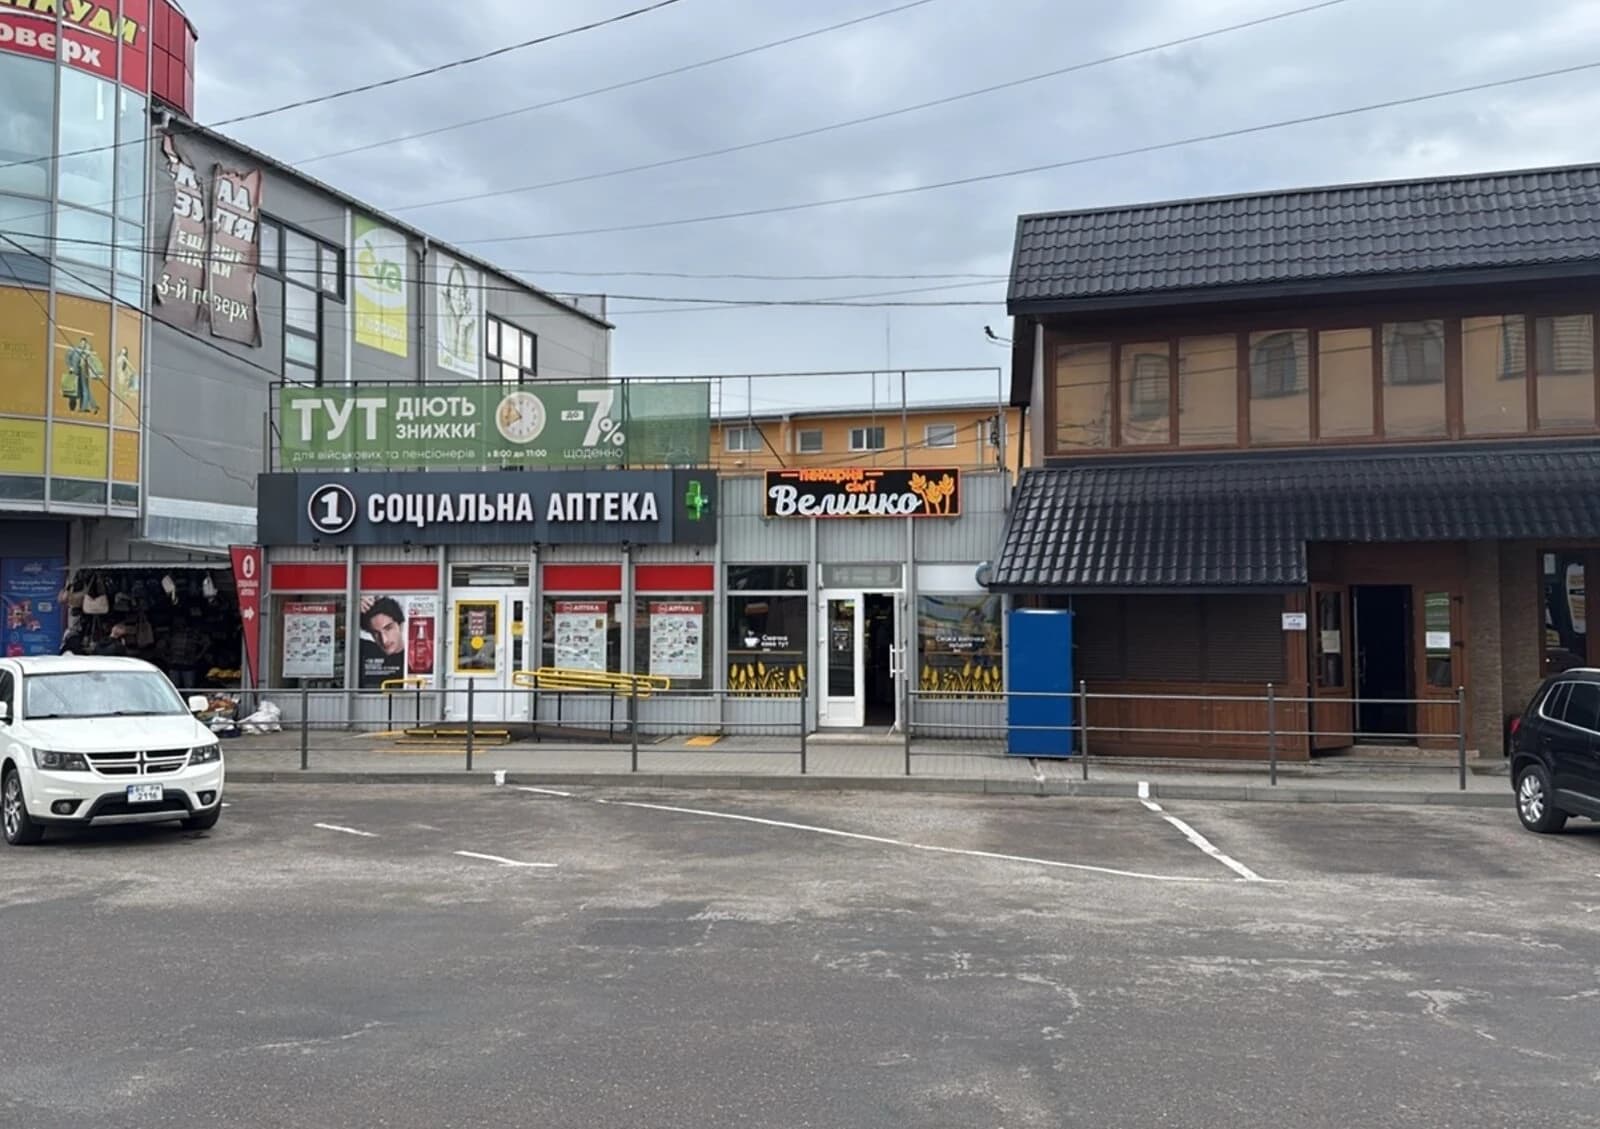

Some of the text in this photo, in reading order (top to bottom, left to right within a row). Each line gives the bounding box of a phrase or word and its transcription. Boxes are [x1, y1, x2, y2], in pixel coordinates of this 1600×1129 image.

[291, 398, 387, 441] ТУТ
[395, 397, 476, 421] ДІЮТЬ
[395, 423, 476, 439] ЗНИЖКИ
[292, 451, 315, 462] для
[402, 449, 475, 463] пенсіонерів
[563, 448, 624, 460] щоденно
[320, 491, 658, 527] 1 СОЦІАЛЬНА АПТЕКА
[768, 484, 923, 515] Величко
